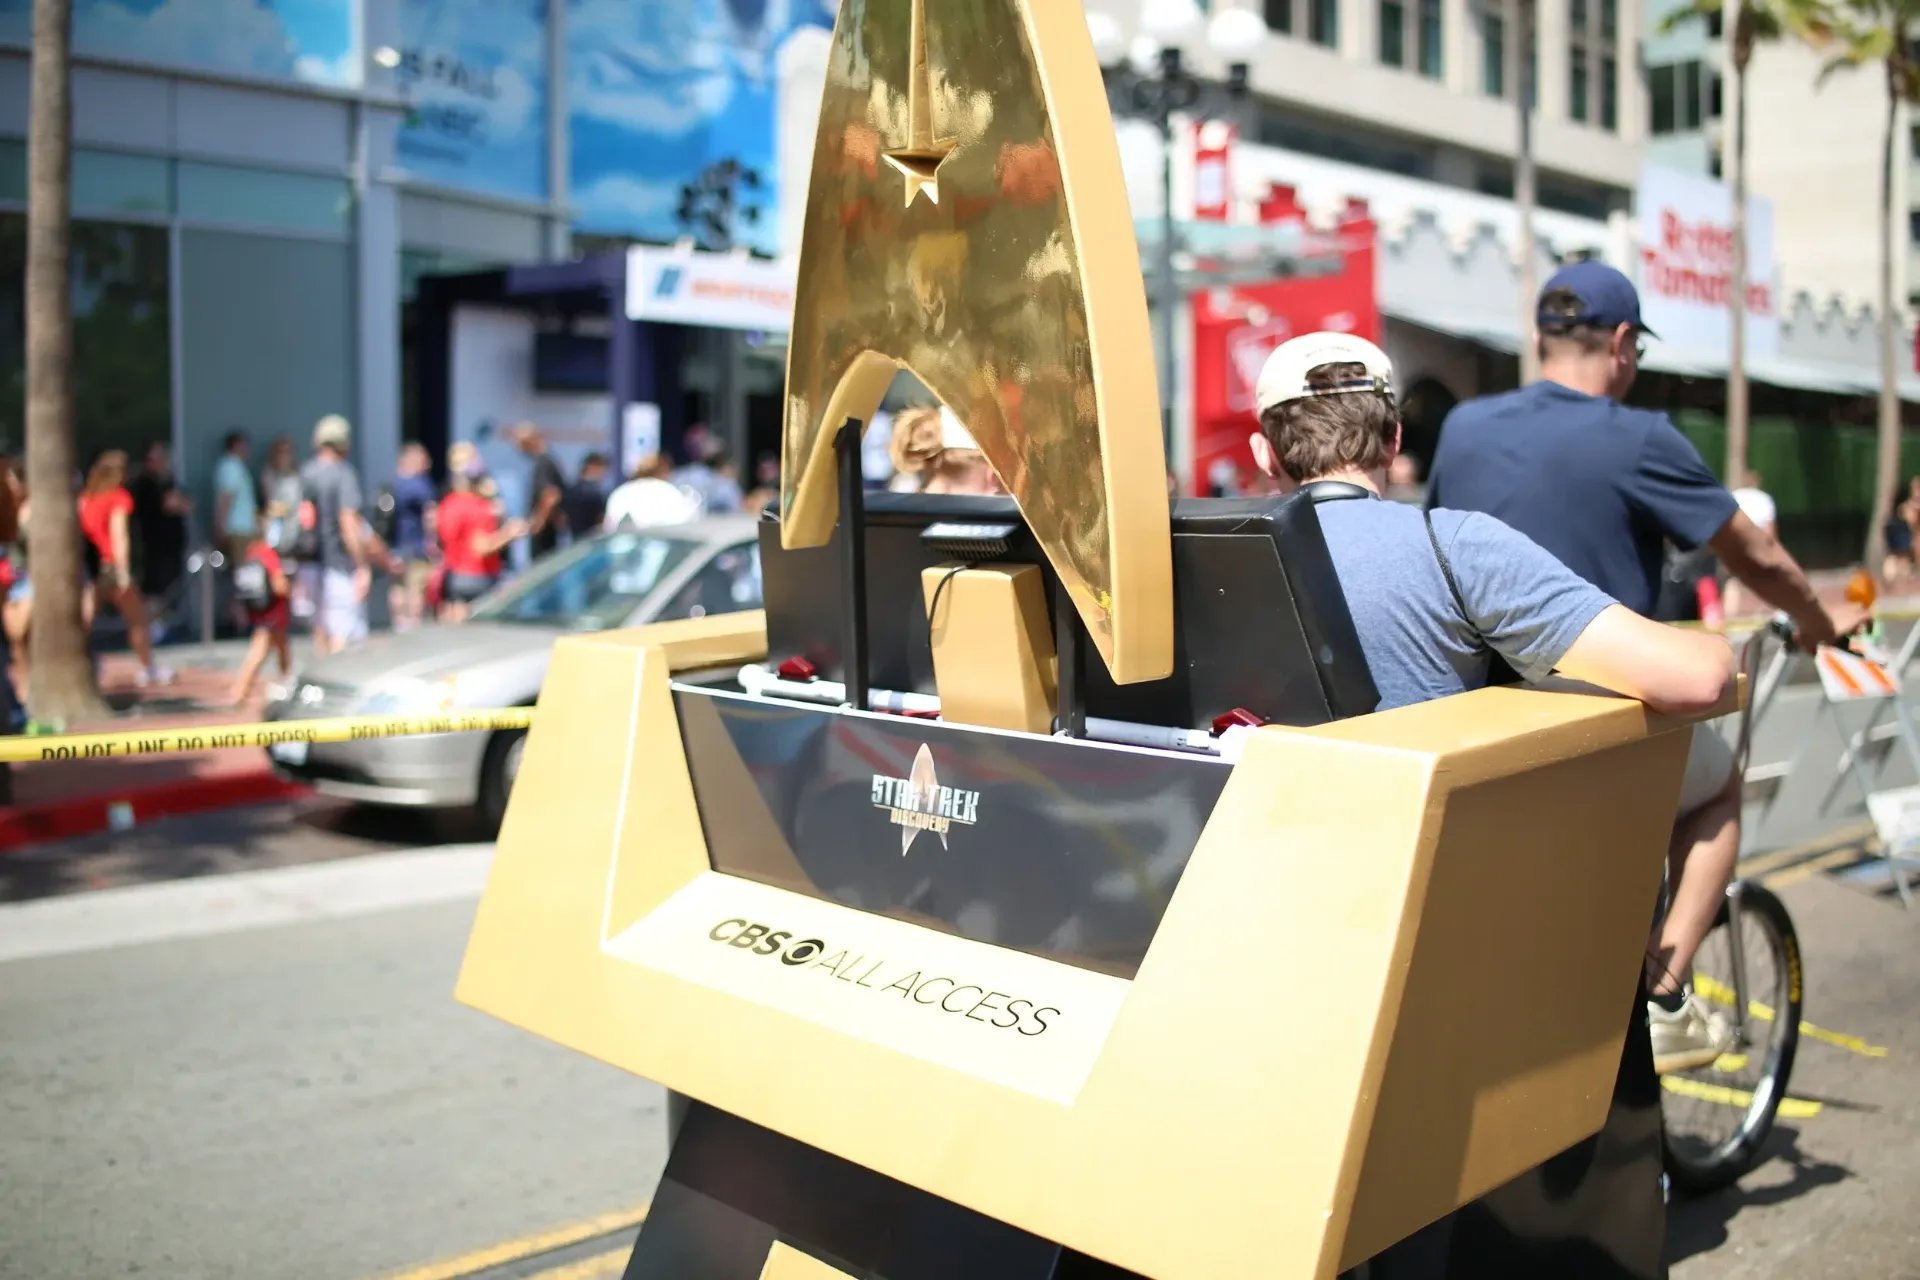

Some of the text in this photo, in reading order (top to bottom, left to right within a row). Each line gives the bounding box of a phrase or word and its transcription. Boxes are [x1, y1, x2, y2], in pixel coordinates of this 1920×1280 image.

[871, 774, 980, 823] STAR TREK
[890, 808, 950, 834] DISCOVERY
[708, 918, 1061, 1036] CBS ALL ACCESS
